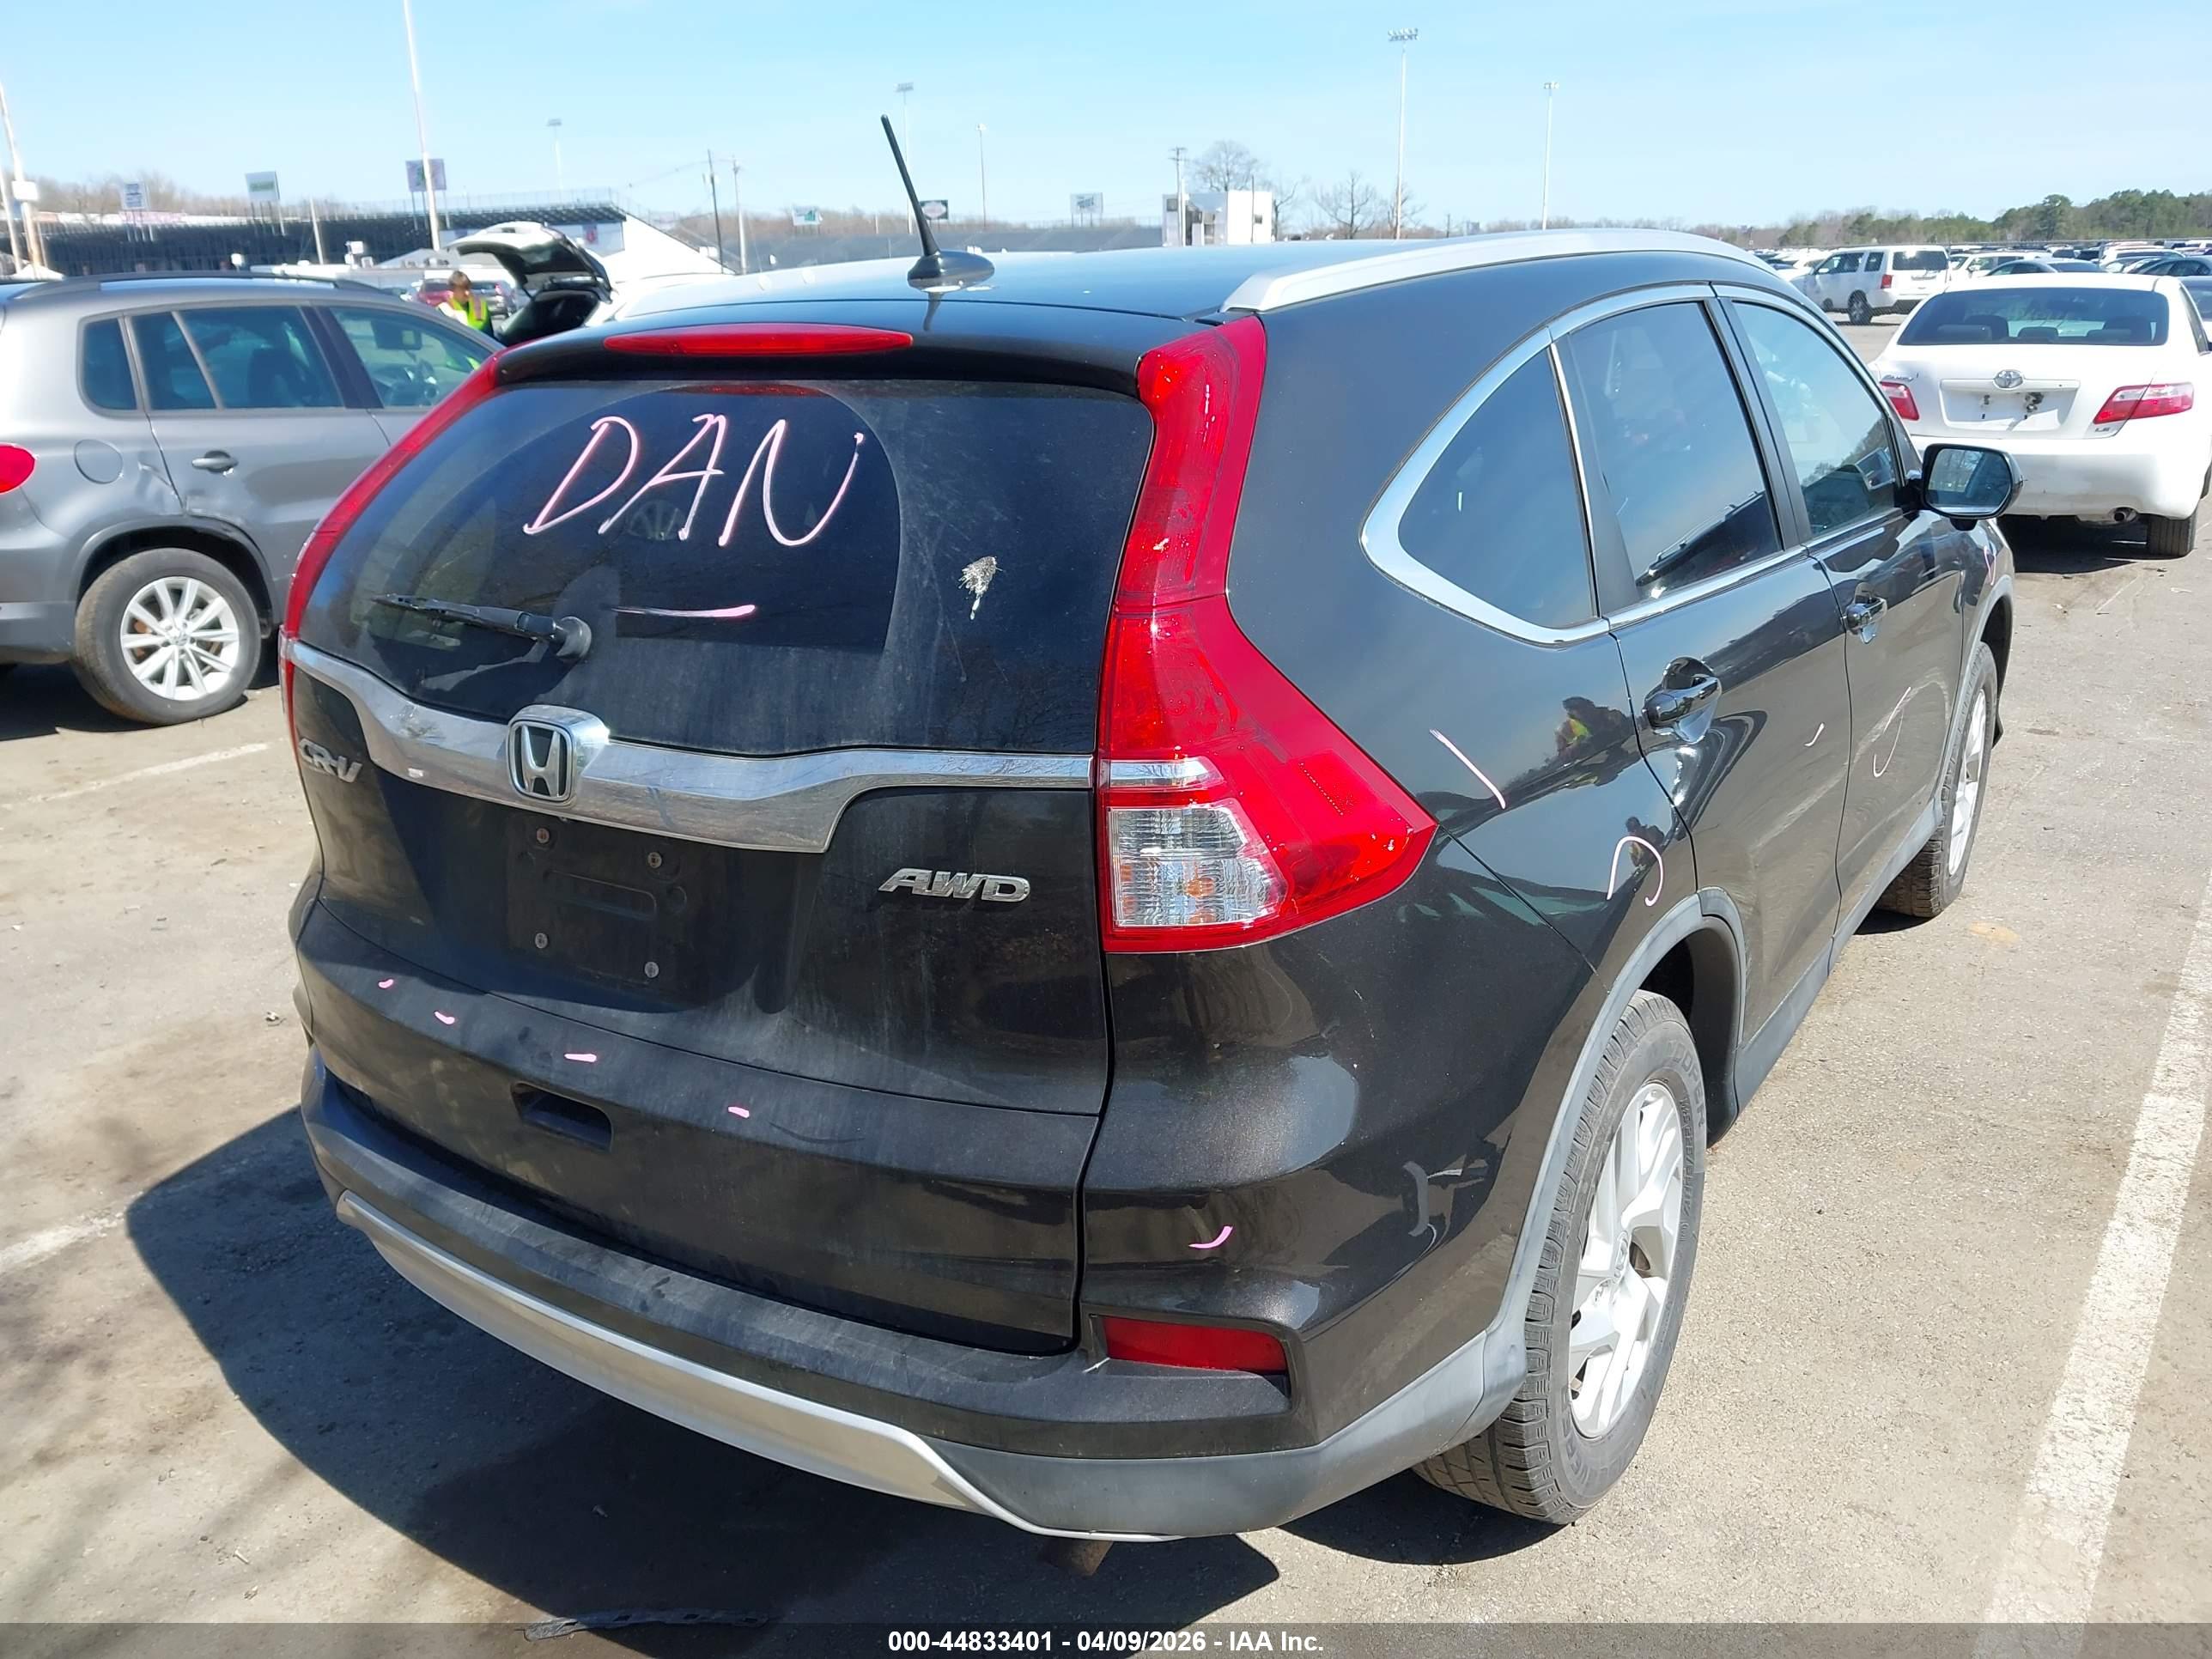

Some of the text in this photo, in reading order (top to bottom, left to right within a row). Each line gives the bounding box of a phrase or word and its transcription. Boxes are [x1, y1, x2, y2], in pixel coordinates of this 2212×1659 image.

[523, 414, 864, 548] DAN
[298, 737, 362, 783] CR-V
[878, 868, 1030, 902] AWD
